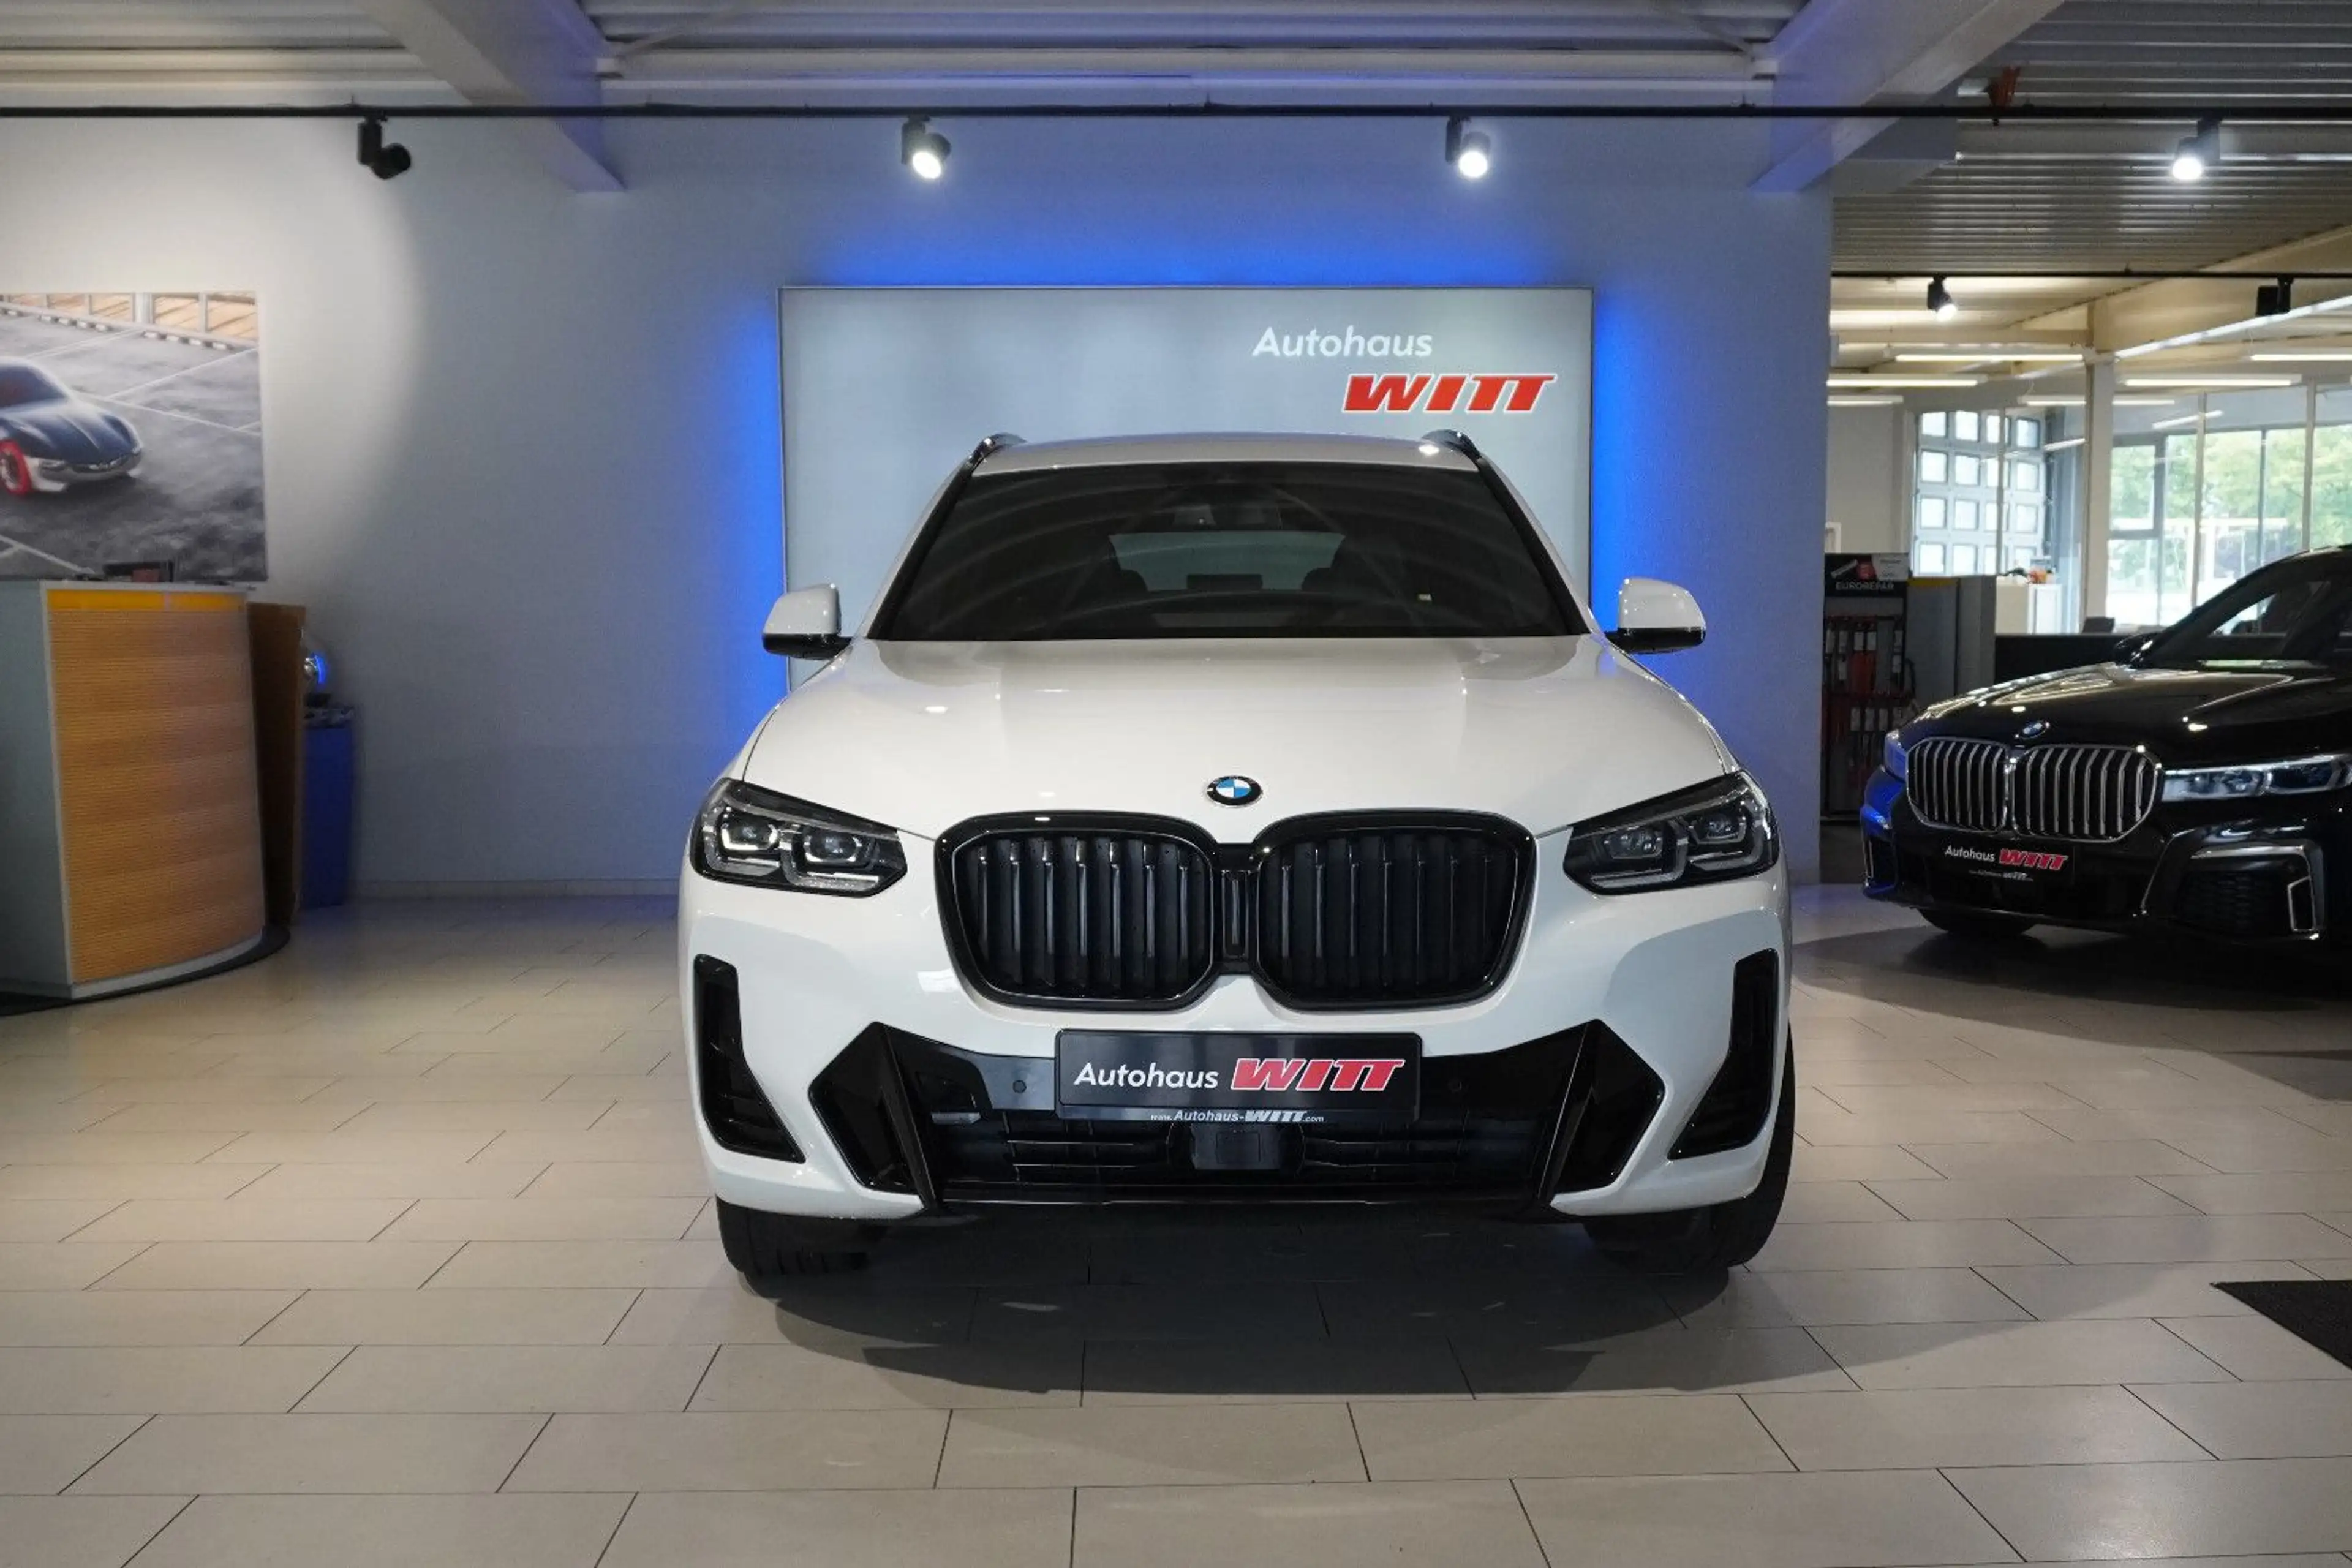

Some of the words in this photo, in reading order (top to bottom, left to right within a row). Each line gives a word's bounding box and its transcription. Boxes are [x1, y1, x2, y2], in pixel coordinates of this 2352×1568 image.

[1252, 325, 1433, 357] Autohaus
[1342, 373, 1557, 413] WITT
[1945, 845, 1996, 862] Autohaus
[1999, 848, 2069, 870] WITT
[1074, 1062, 1219, 1088] Autohaus
[1231, 1058, 1405, 1091] WITT
